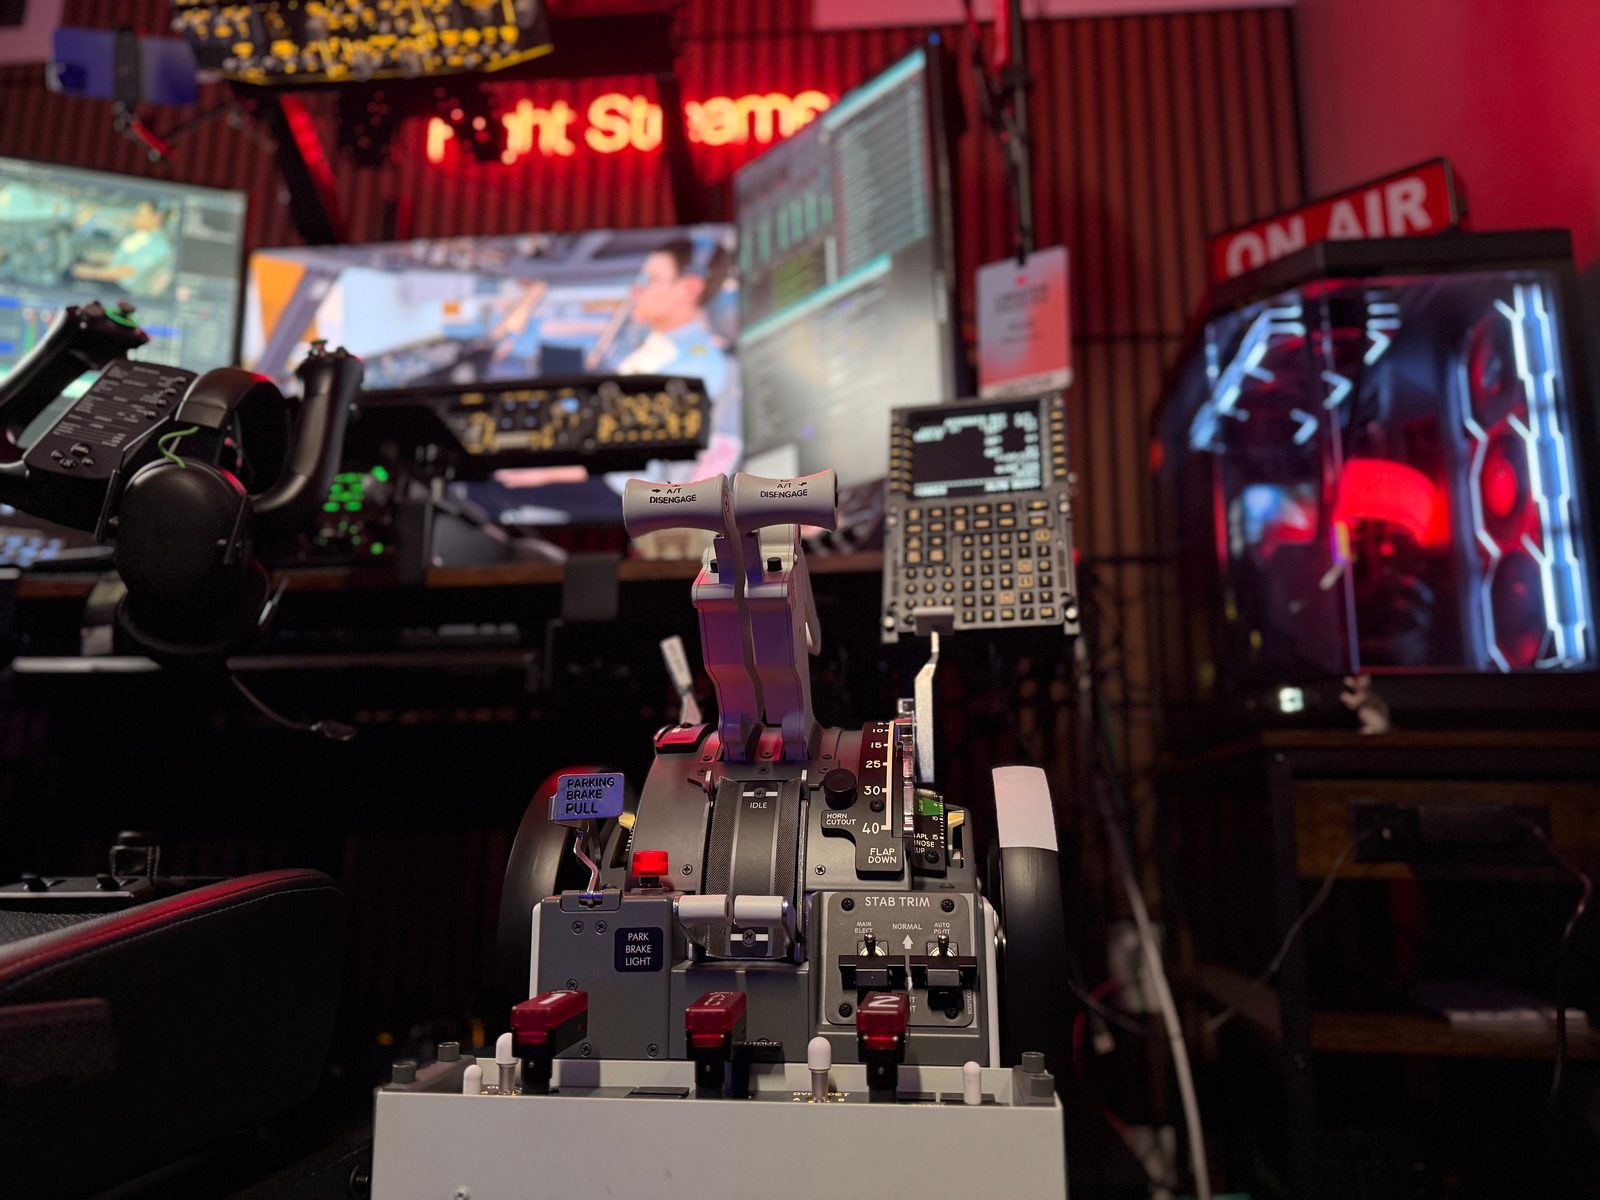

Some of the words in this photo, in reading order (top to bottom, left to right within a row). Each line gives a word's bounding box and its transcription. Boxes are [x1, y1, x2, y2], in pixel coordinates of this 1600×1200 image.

[1226, 217, 1306, 278] ON
[1326, 176, 1433, 242] AIR
[760, 488, 808, 499] DISENGAGE
[649, 494, 697, 504] DISENGAGE
[865, 760, 881, 769] 25
[566, 776, 615, 789] PARKING
[565, 788, 603, 800] BRAKE
[863, 786, 881, 796] 30
[565, 801, 598, 815] PULL
[749, 801, 768, 809] IDLE
[826, 818, 857, 826] CUTOUT
[862, 822, 880, 835] 40
[870, 848, 896, 856] FLAP
[868, 856, 897, 864] DOWN
[864, 896, 896, 907] STAB
[898, 896, 931, 907] TRIM
[892, 923, 923, 931] NORMAL
[627, 932, 649, 941] PARK
[625, 944, 652, 954] BRAKE
[625, 956, 652, 966] LIGHT
[868, 994, 901, 1008] 2
